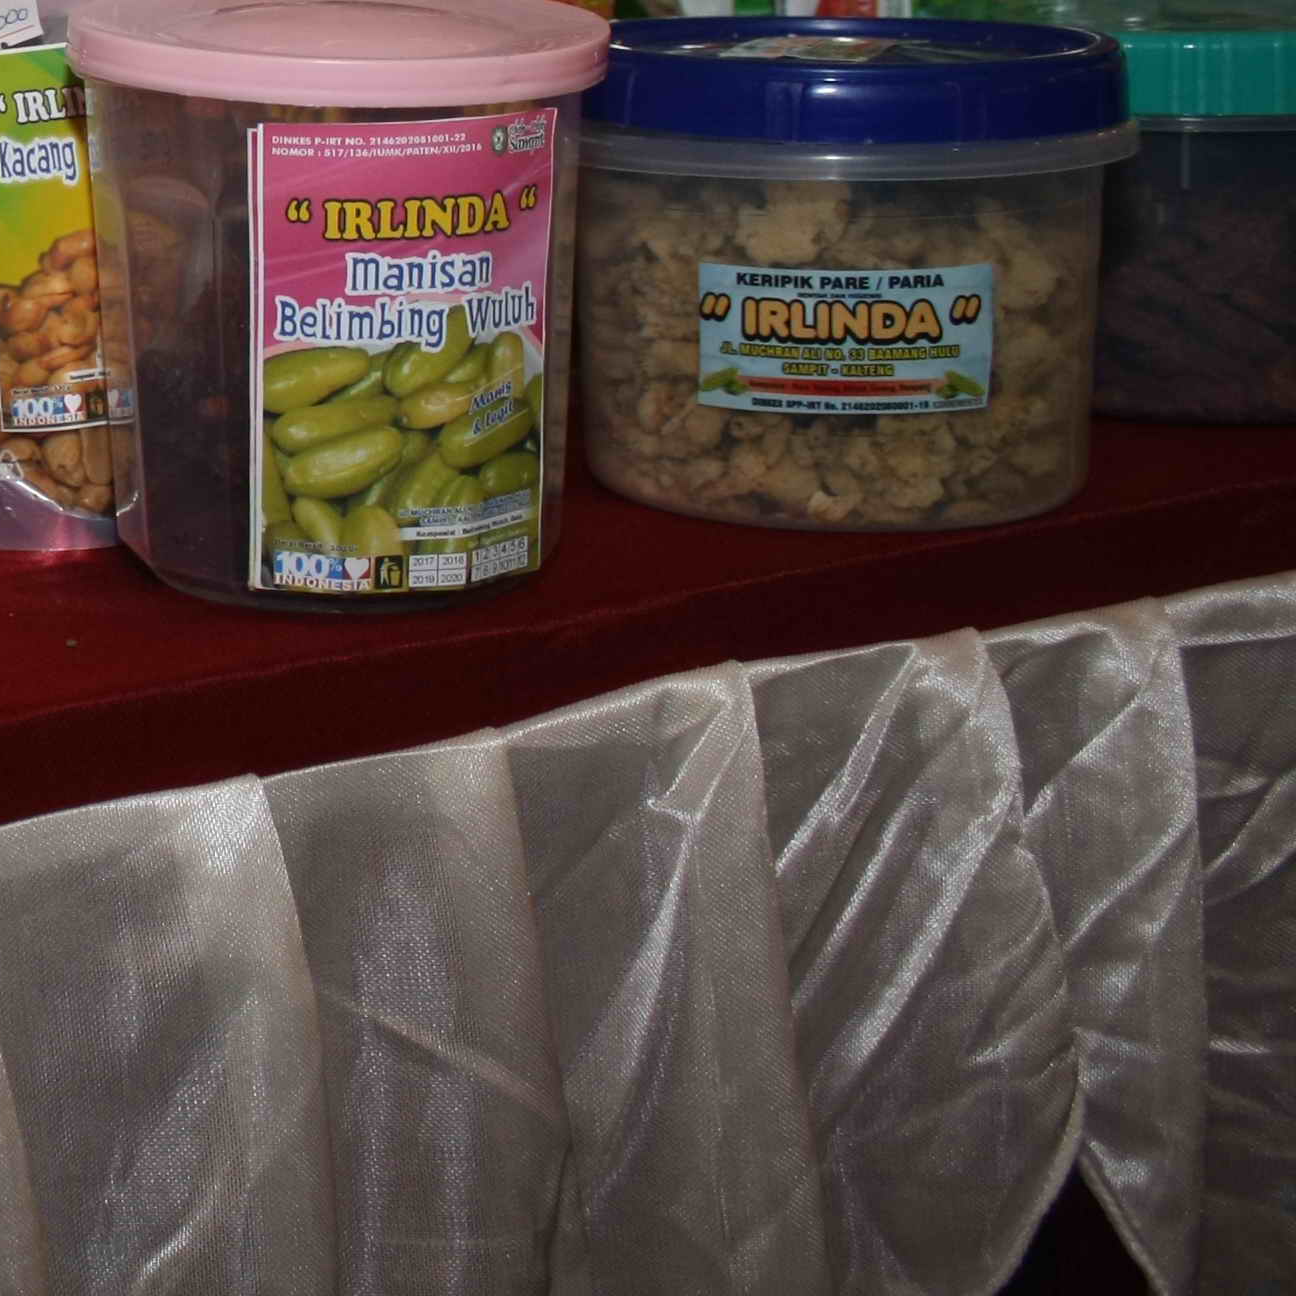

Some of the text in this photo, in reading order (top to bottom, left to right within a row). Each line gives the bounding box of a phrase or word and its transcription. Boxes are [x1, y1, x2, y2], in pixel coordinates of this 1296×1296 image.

[271, 134, 312, 146] DINKES
[271, 146, 315, 157] NOMOR
[323, 192, 510, 240] IRLINDA
[736, 272, 814, 290] KERIPIK
[819, 275, 870, 290] PARE
[888, 274, 945, 290] PARIA
[277, 285, 536, 348] Belimbing Wuluh
[741, 296, 943, 345] IRLINDA
[469, 380, 513, 414] Manis
[273, 551, 343, 577] 100%
[274, 575, 373, 592] INDONESIA
